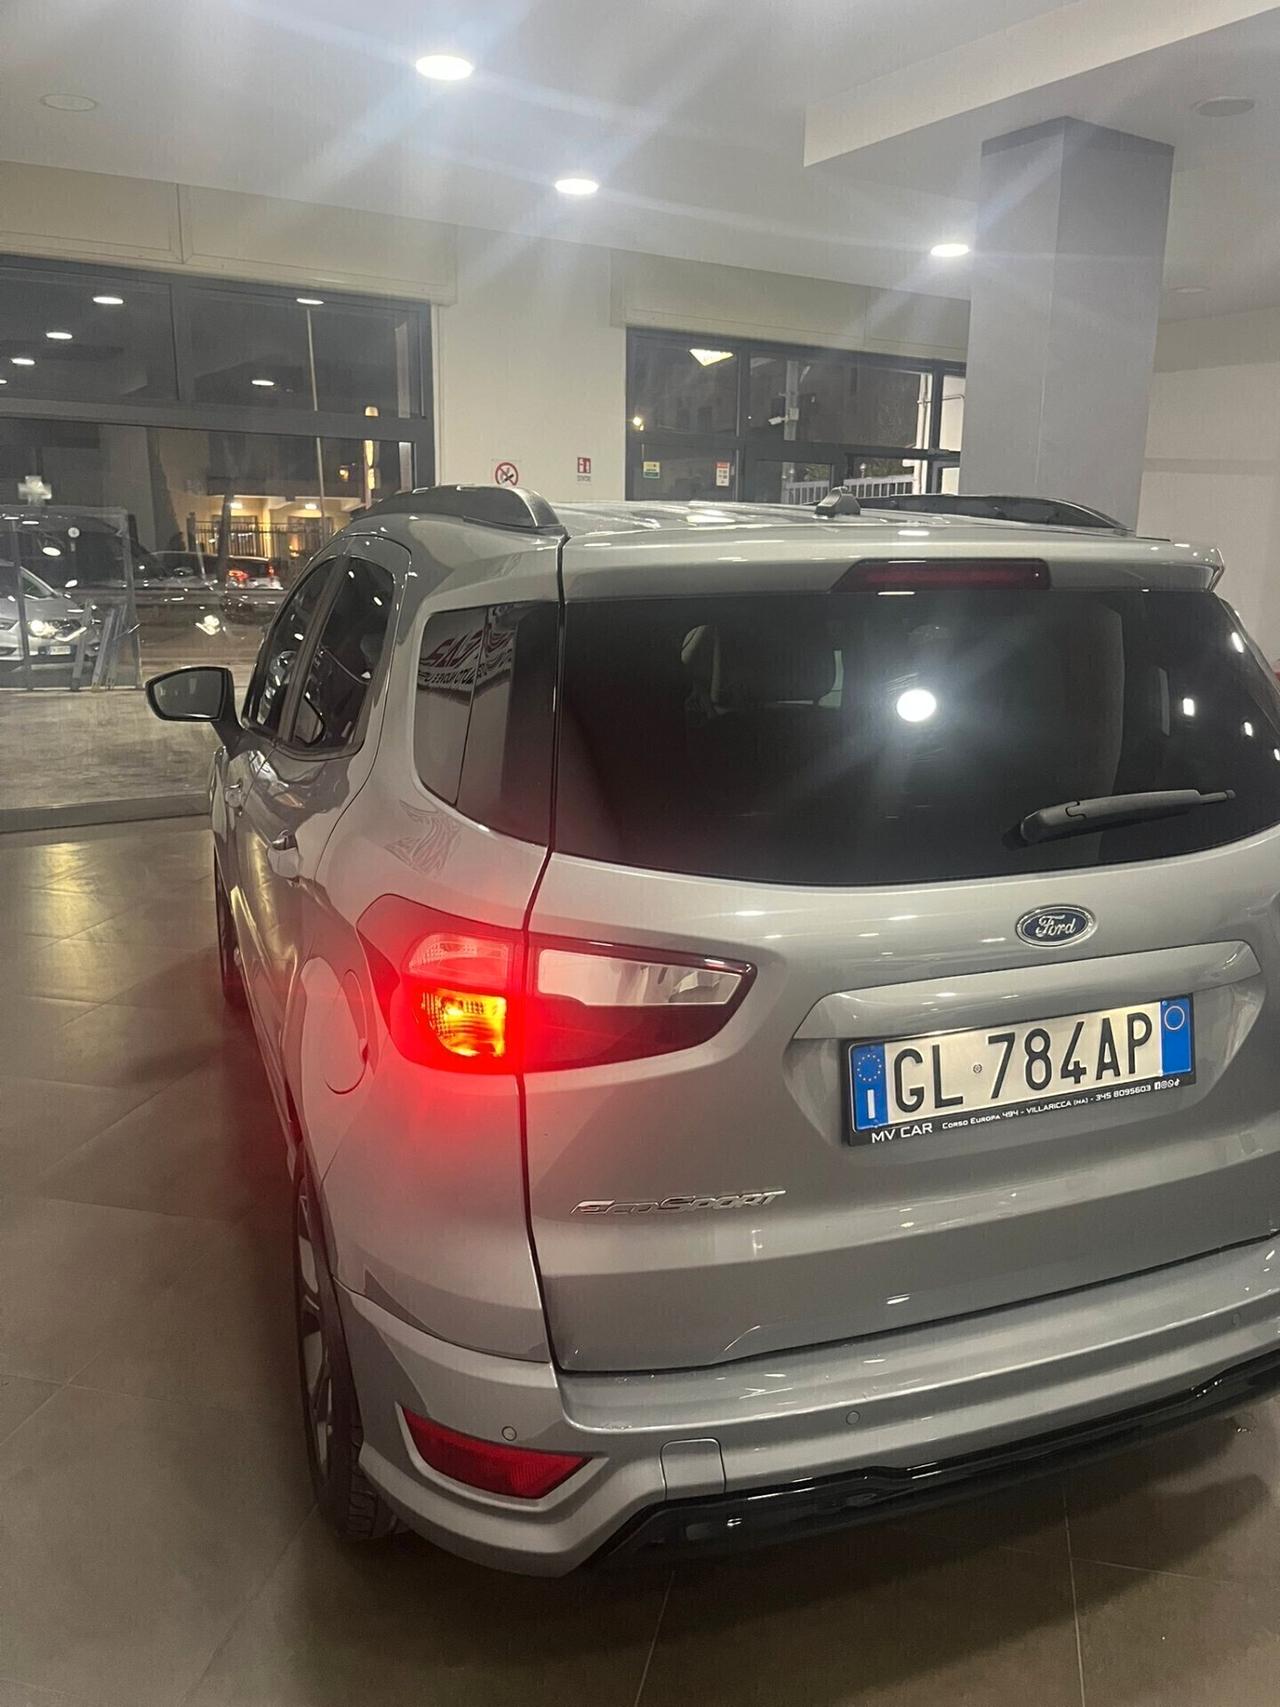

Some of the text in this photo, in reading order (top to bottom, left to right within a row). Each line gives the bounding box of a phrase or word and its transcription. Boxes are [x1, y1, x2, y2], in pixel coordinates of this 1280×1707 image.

[1035, 914, 1076, 938] Ford
[893, 1011, 1153, 1114] GL 784AP
[1026, 1100, 1073, 1115] VILLARICCA
[1095, 1092, 1112, 1102] 345
[871, 1122, 933, 1144] MV CAR
